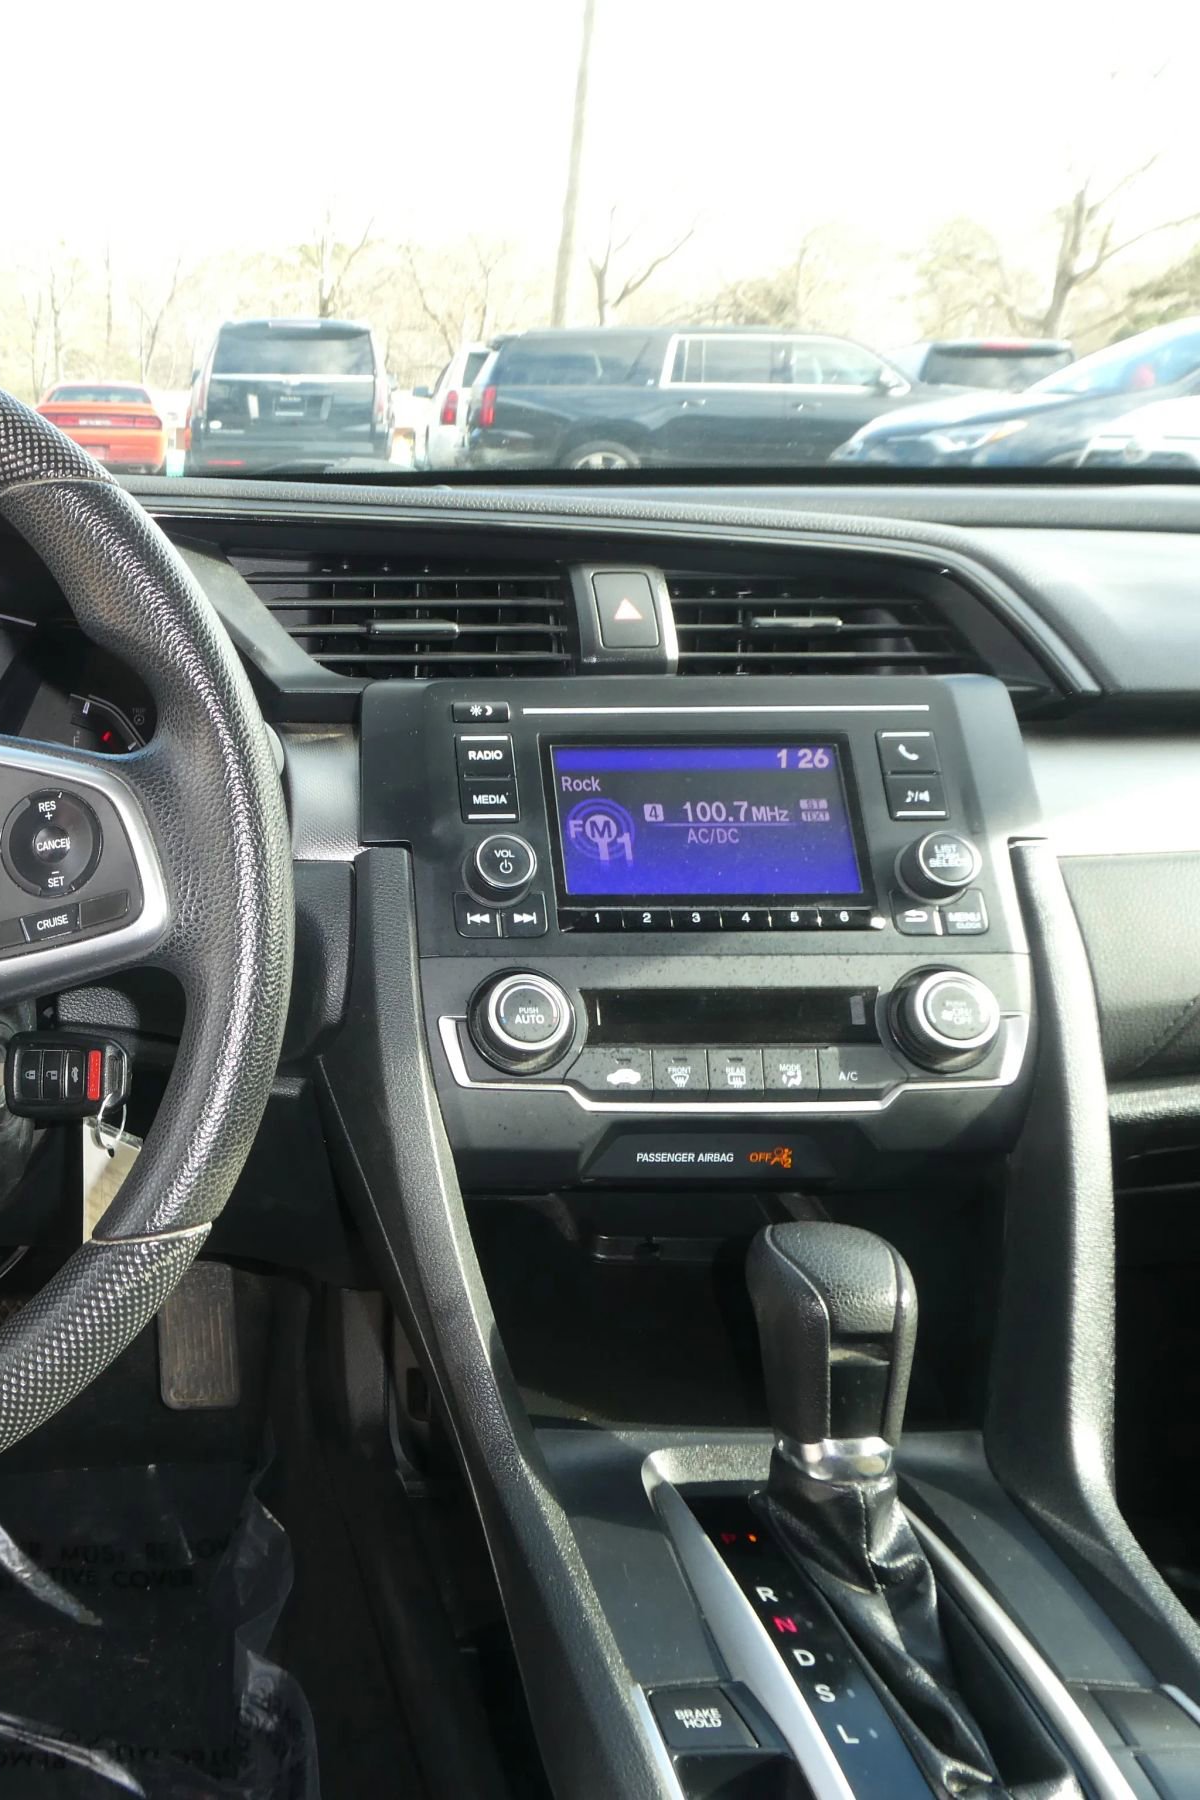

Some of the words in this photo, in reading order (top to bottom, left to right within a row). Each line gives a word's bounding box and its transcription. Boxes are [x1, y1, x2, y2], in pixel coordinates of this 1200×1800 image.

[468, 750, 503, 761] RADIO
[560, 775, 602, 792] Rock
[472, 794, 508, 805] MEDIA
[37, 800, 57, 813] RES
[682, 801, 749, 823] 100.7
[751, 805, 790, 822] MHz
[687, 828, 740, 845] AC/DC
[494, 849, 515, 859] VOL
[47, 876, 65, 888] SET
[36, 913, 69, 932] CRUISE
[594, 912, 601, 924] 1
[642, 912, 652, 923] 2
[691, 912, 701, 923] 3
[740, 912, 751, 923] 4
[790, 911, 800, 923] 5
[839, 911, 849, 922] 6
[518, 1006, 539, 1014] PUSH
[514, 1014, 545, 1025] AUTO
[667, 1066, 692, 1074] FRONT
[725, 1066, 746, 1075] REAR
[779, 1064, 802, 1072] MODE
[838, 1070, 859, 1082] A/C
[636, 1151, 695, 1163] PASSENGER
[697, 1151, 734, 1163] AIRBAG
[749, 1151, 772, 1163] OFF
[755, 1586, 779, 1602] R
[771, 1616, 798, 1633] N
[792, 1649, 816, 1667] D
[814, 1683, 836, 1703] S
[674, 1707, 722, 1721] BRAKE
[683, 1715, 723, 1729] HOLD
[836, 1724, 860, 1745] L
